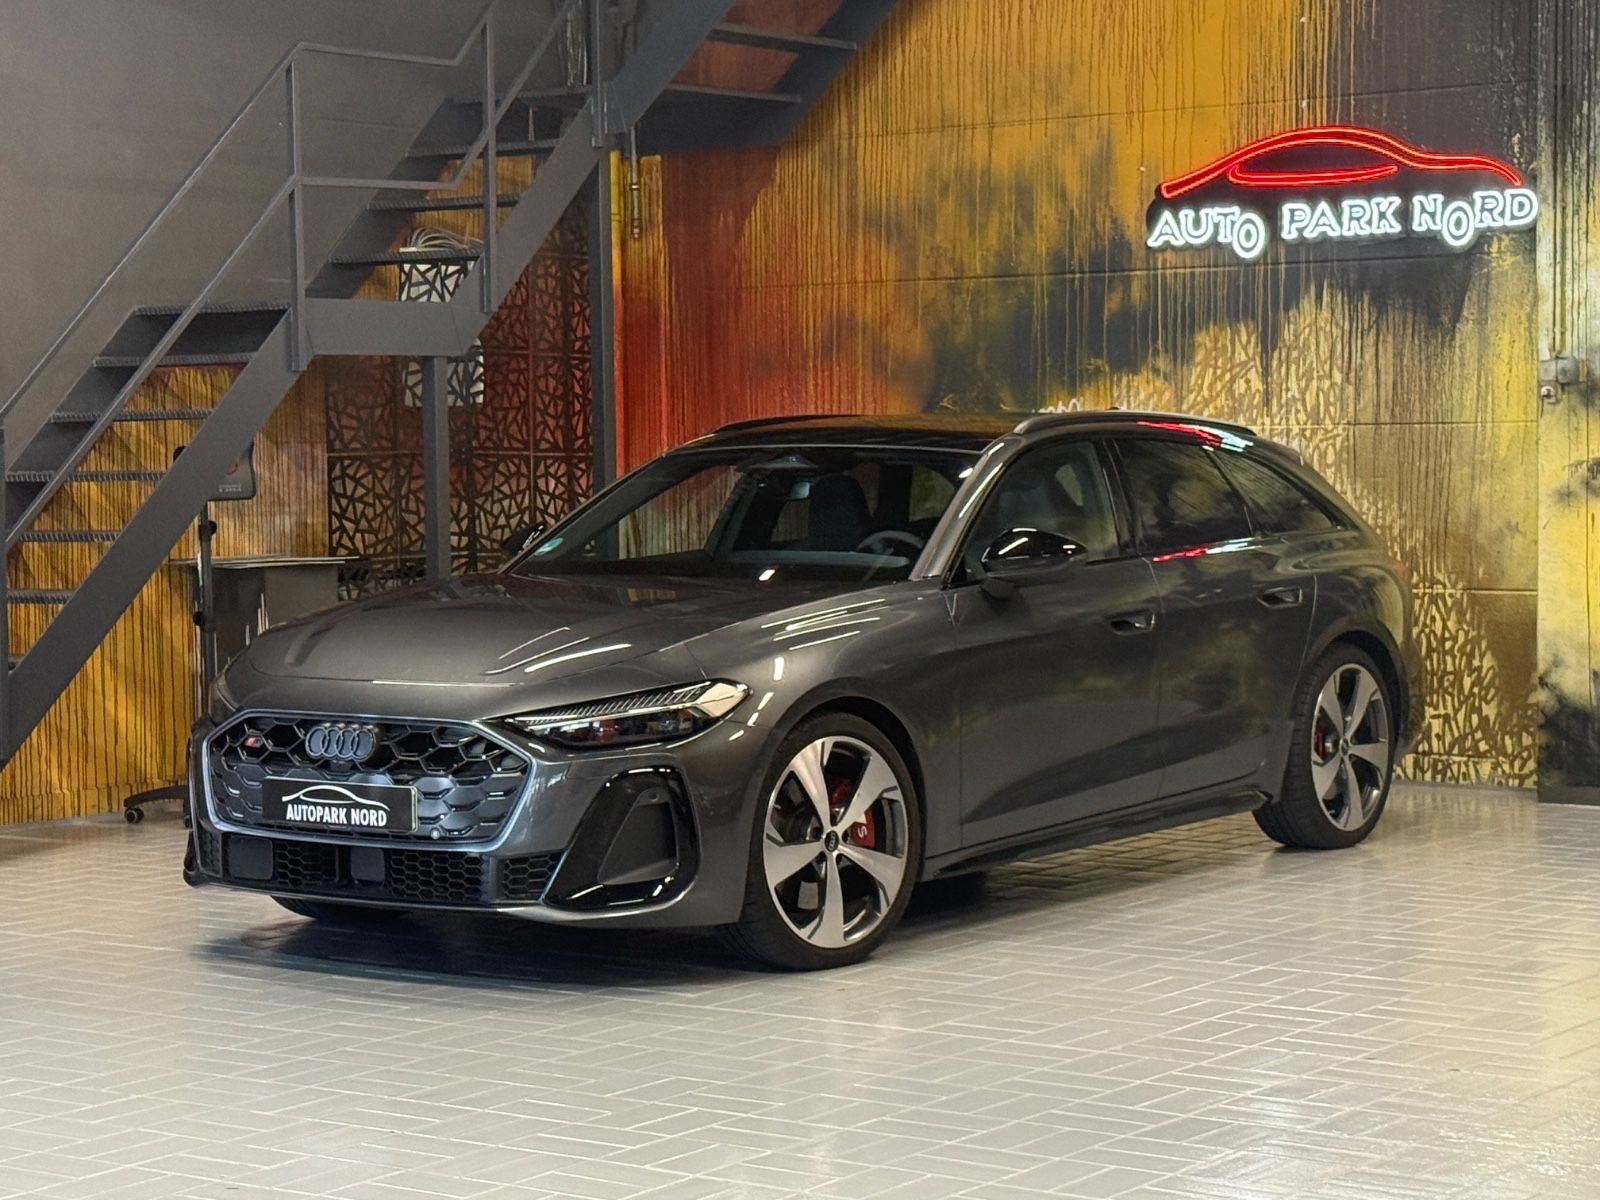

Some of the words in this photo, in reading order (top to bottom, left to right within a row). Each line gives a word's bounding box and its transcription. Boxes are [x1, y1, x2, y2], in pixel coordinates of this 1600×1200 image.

[1147, 206, 1266, 259] AUTO
[1281, 195, 1401, 241] PARK
[1411, 187, 1539, 248] NORD
[286, 803, 348, 824] AUTOPARK
[350, 808, 387, 827] NORD
